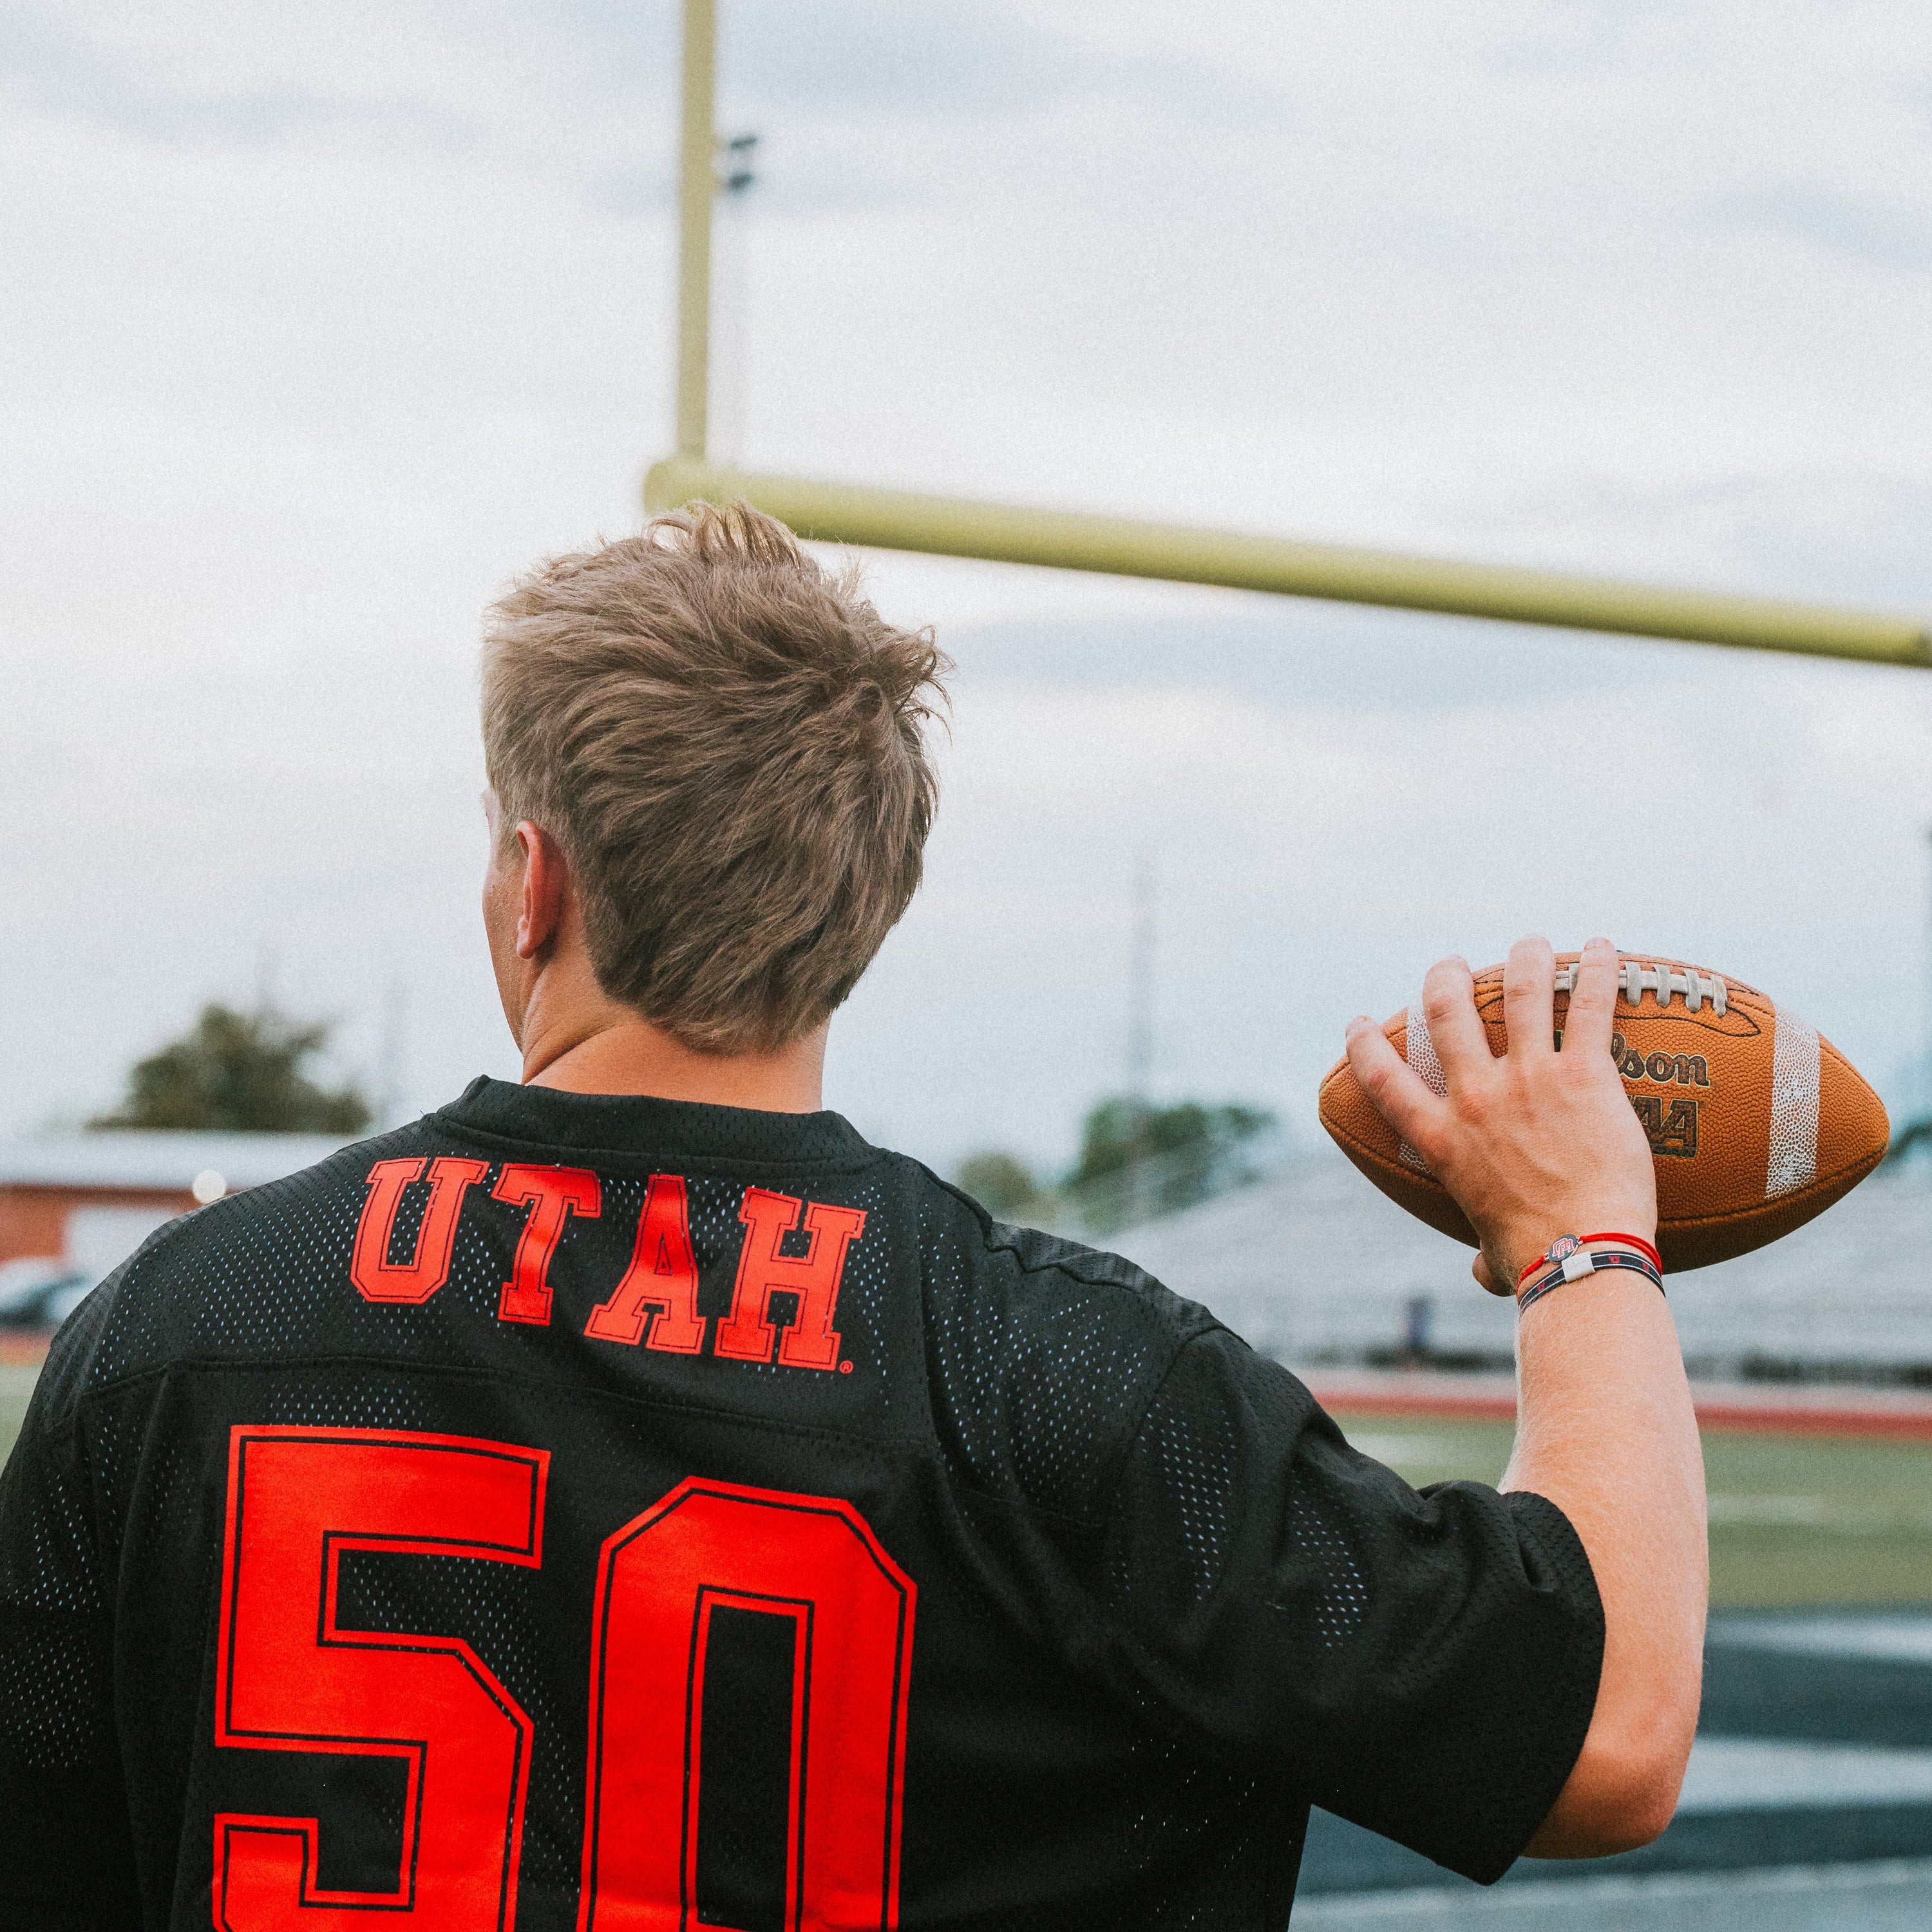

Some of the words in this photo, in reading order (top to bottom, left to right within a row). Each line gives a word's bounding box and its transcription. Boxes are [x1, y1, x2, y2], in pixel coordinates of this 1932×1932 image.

[1553, 1030, 1710, 1088] lson
[1627, 1095, 1698, 1159] AA
[350, 1157, 865, 1371] UTAH
[211, 1424, 918, 1932] 50
